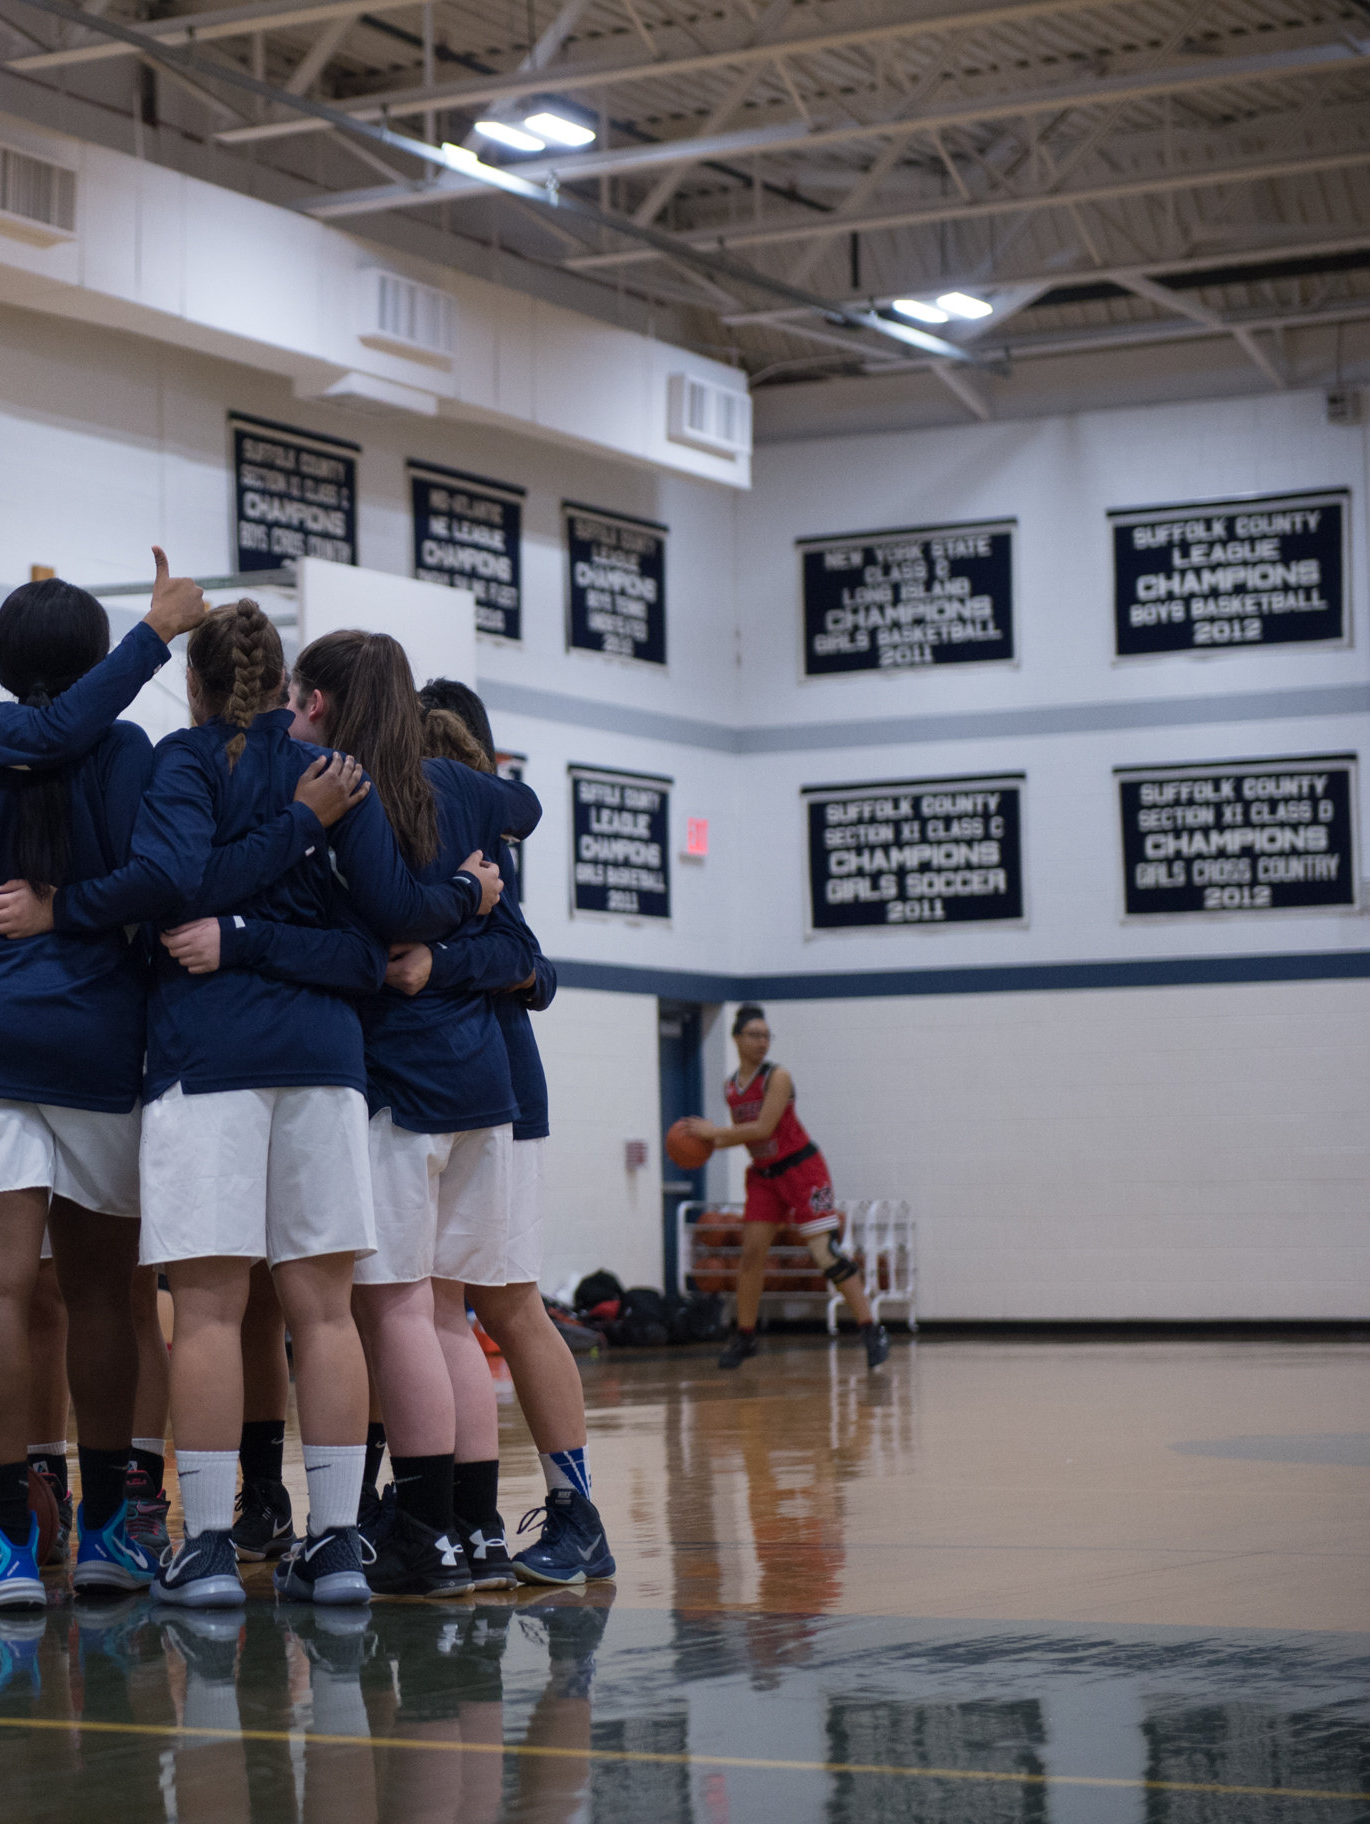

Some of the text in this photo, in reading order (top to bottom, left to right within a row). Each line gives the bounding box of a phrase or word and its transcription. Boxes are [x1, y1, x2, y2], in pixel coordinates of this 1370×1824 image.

[242, 489, 347, 539] CHAMPIONS
[1132, 509, 1322, 550] SUFFOLK COUNTY
[824, 536, 992, 572] NEW YORK STATE
[1172, 537, 1281, 569] LEAGUE
[863, 561, 928, 583] CLASS
[1136, 558, 1321, 602] CHAMPIONS
[842, 576, 971, 608] LONG ISLAND
[1129, 587, 1328, 628] BOYS BASKETBALL
[825, 594, 993, 631] CHAMPIONS
[814, 618, 1003, 656] GIRLS BASKETBALL
[1192, 617, 1264, 646] 2012
[879, 645, 934, 667] 2011
[824, 791, 1001, 825] SUFFOLK COUNTY
[1139, 774, 1328, 806] SUFFOLK COUNTY
[823, 822, 895, 849] SECTION
[900, 820, 921, 843] XI
[926, 816, 984, 841] CLASS
[1137, 803, 1216, 833] SECTION
[1221, 802, 1244, 826] XI
[1250, 798, 1313, 823] CLASS
[580, 834, 661, 870] CHAMPIONS
[828, 840, 1001, 877] CHAMPIONS
[1144, 825, 1329, 861] CHAMPIONS
[825, 867, 1008, 905] GIRLS SOCCER
[1135, 853, 1340, 890] GIRLS CROSS COUNTRY
[885, 899, 946, 924] 2011
[1203, 885, 1273, 910] 2012
